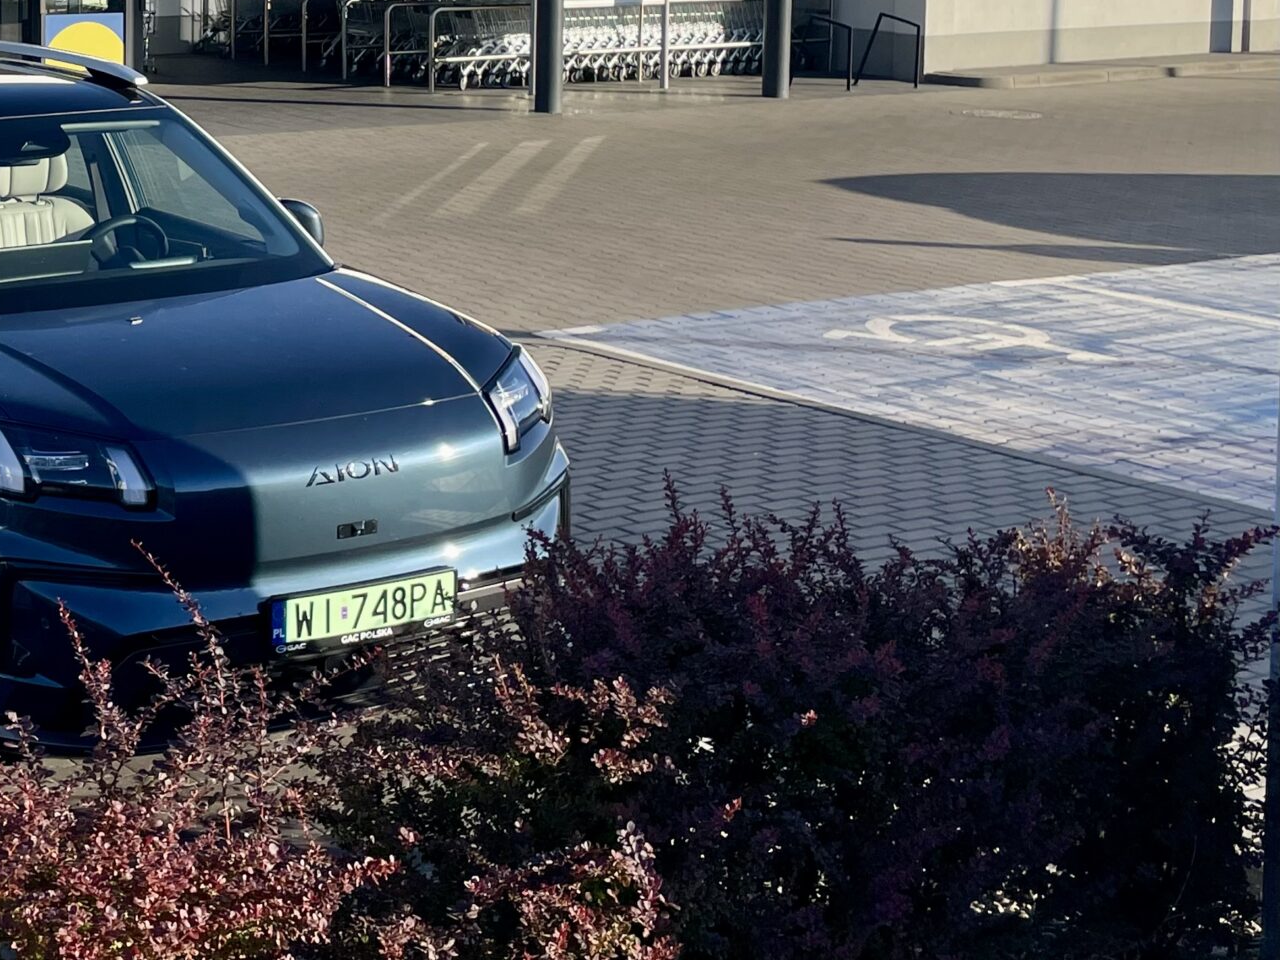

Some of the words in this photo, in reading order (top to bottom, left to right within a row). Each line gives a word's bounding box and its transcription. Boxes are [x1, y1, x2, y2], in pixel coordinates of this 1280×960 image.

[306, 454, 399, 487] AION
[273, 628, 285, 639] PL
[341, 633, 360, 644] GAC
[360, 627, 394, 641] POLSKA
